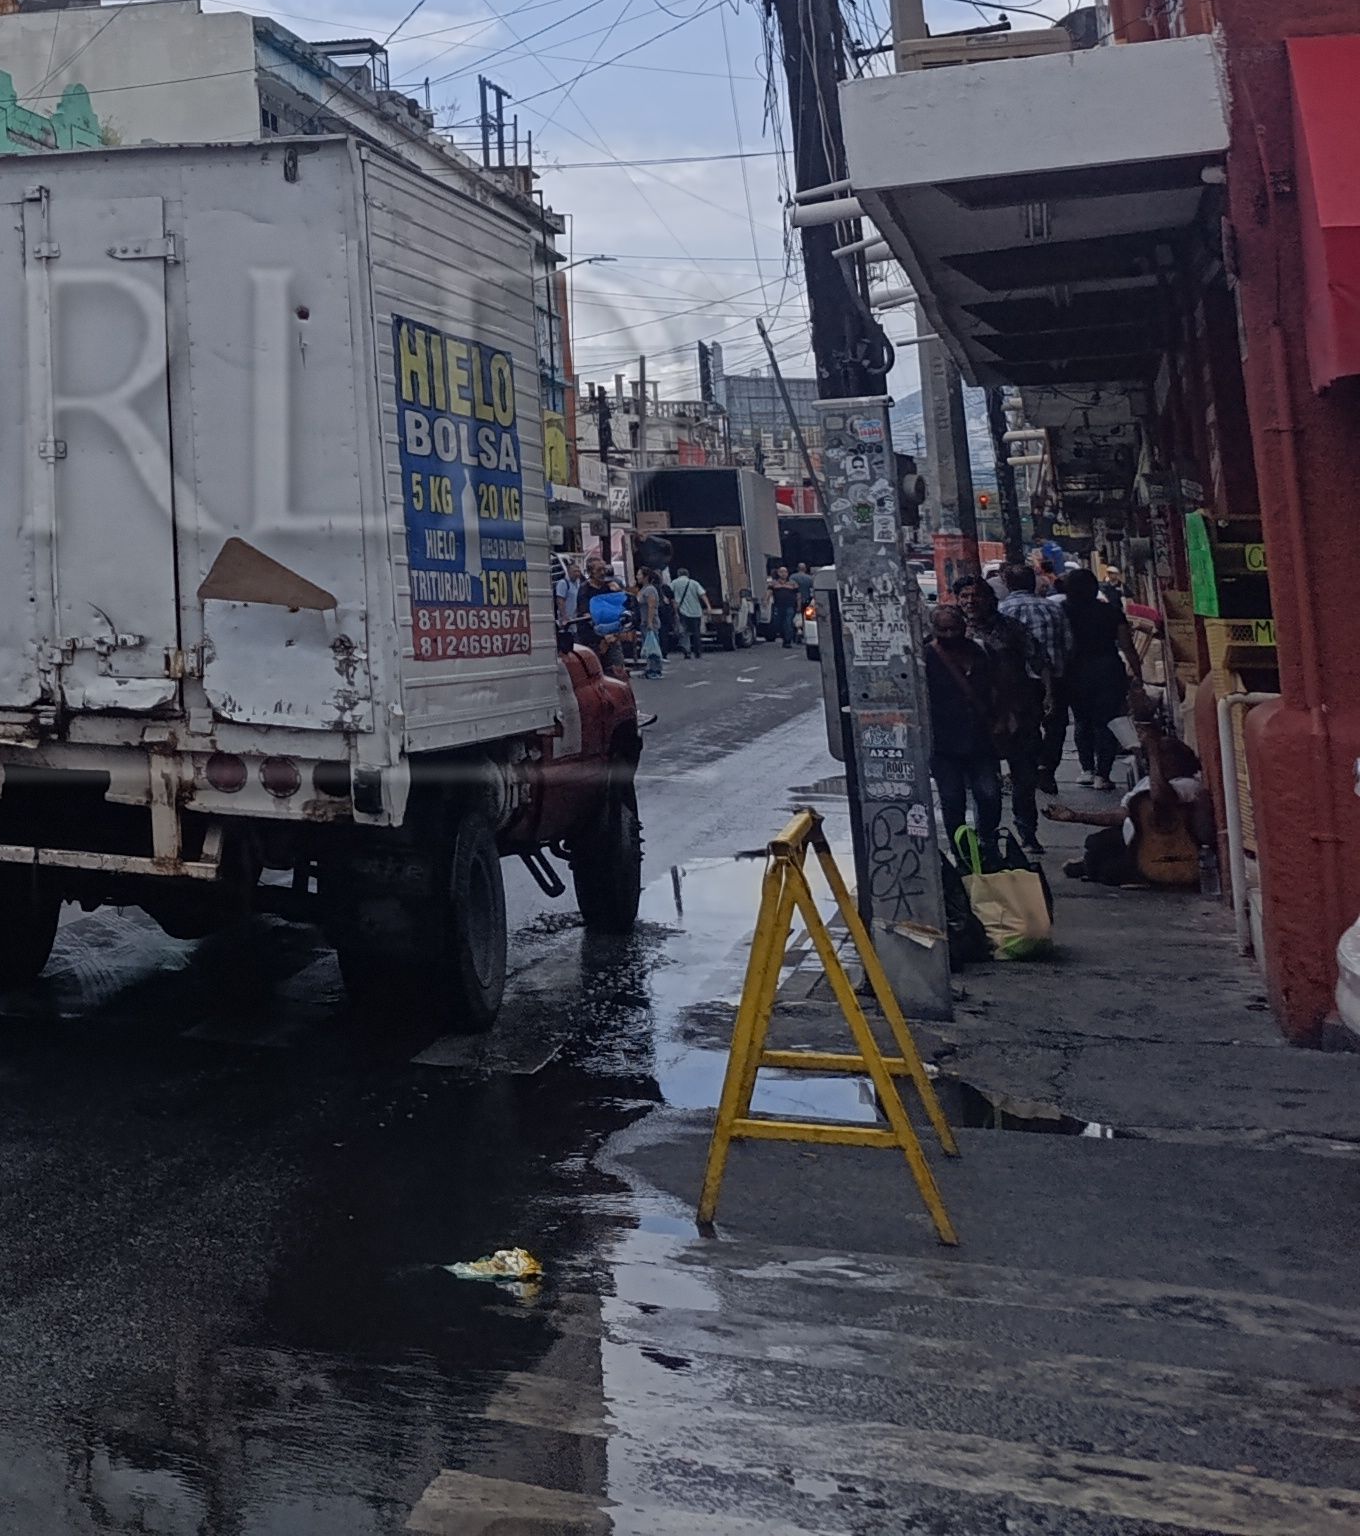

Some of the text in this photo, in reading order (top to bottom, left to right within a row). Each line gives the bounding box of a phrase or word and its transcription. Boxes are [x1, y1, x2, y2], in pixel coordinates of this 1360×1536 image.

[397, 321, 516, 429] HIELO
[404, 409, 520, 474] BOLSA
[411, 471, 454, 516] 5 KG
[479, 482, 521, 523] 20 KG
[425, 528, 456, 562] HIELO
[411, 569, 472, 604] TRITURADO
[481, 569, 529, 607] 150 KG
[418, 607, 529, 631] 8120639671
[419, 632, 530, 657] 8124698729
